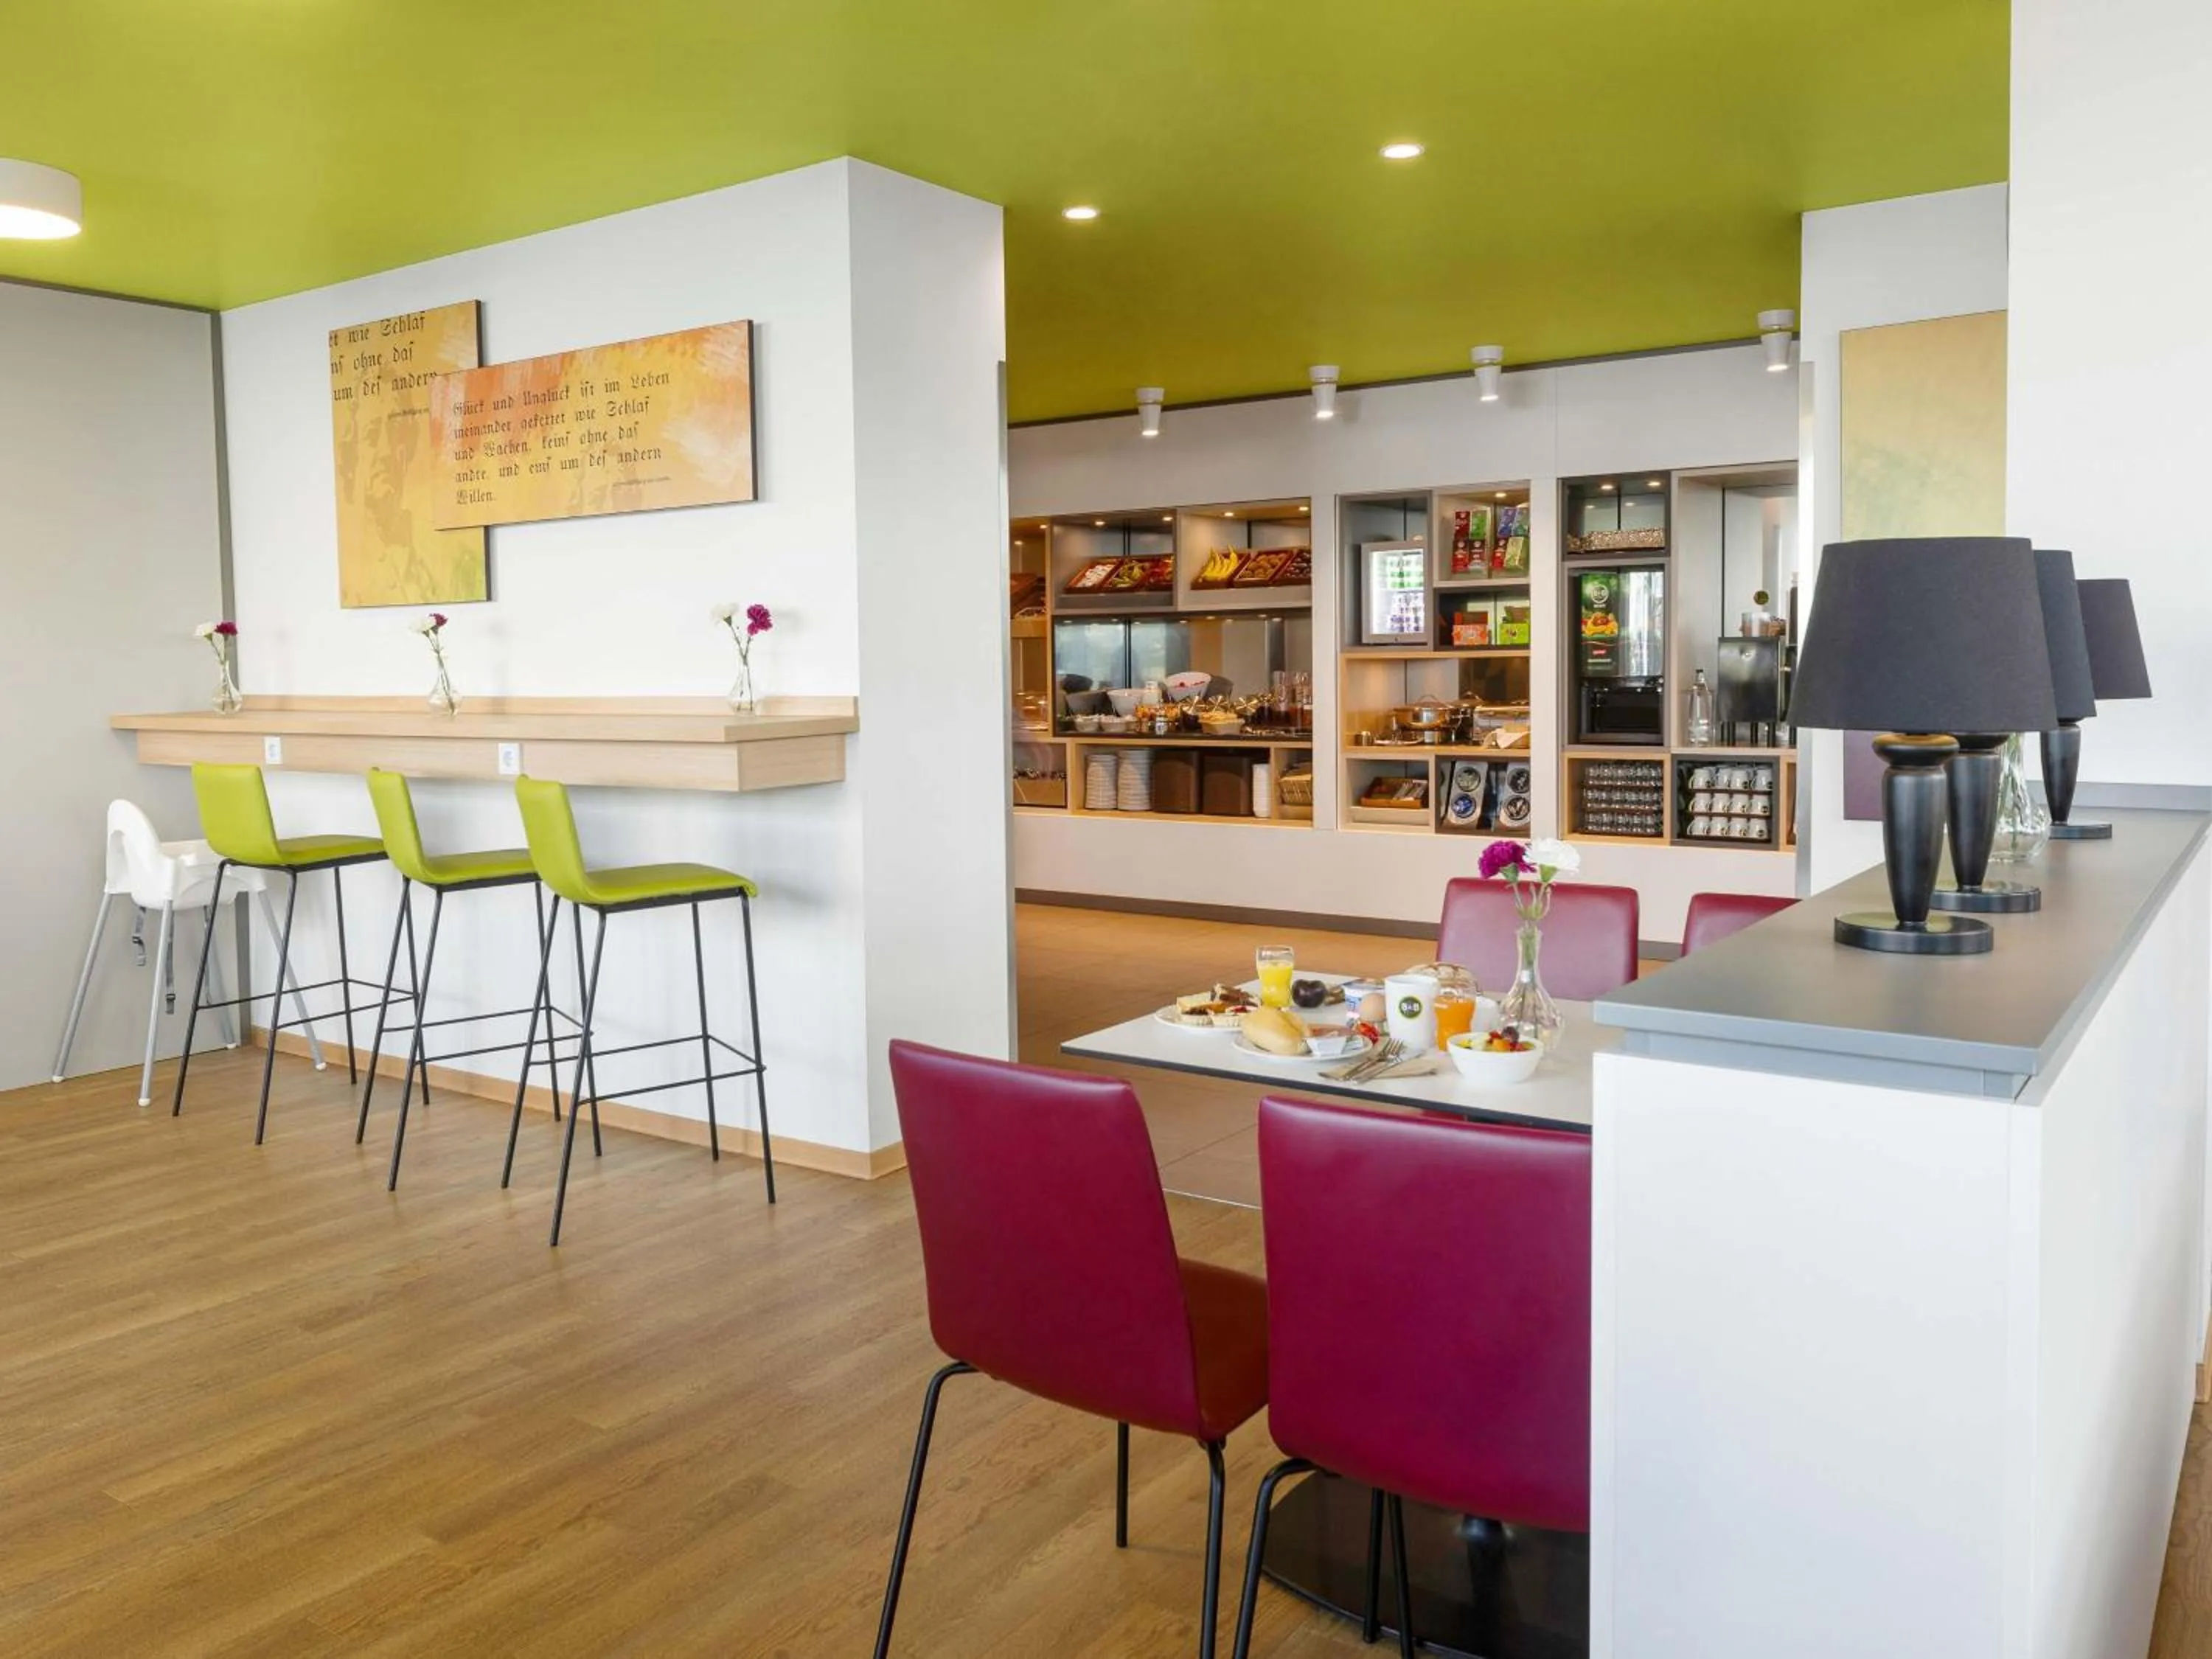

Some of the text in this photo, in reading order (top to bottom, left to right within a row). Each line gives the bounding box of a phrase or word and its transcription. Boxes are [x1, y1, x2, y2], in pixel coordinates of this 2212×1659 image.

[349, 328, 369, 343] wie
[353, 351, 382, 369] ohne
[333, 386, 352, 400] um
[493, 395, 514, 411] und
[605, 378, 619, 393] im
[631, 371, 669, 389] Leben
[575, 408, 596, 422] wie
[607, 396, 650, 417] Schlaf
[454, 448, 474, 461] und
[580, 429, 608, 445] ohne
[499, 465, 519, 478] und
[560, 458, 579, 470] um
[618, 448, 661, 464] andern
